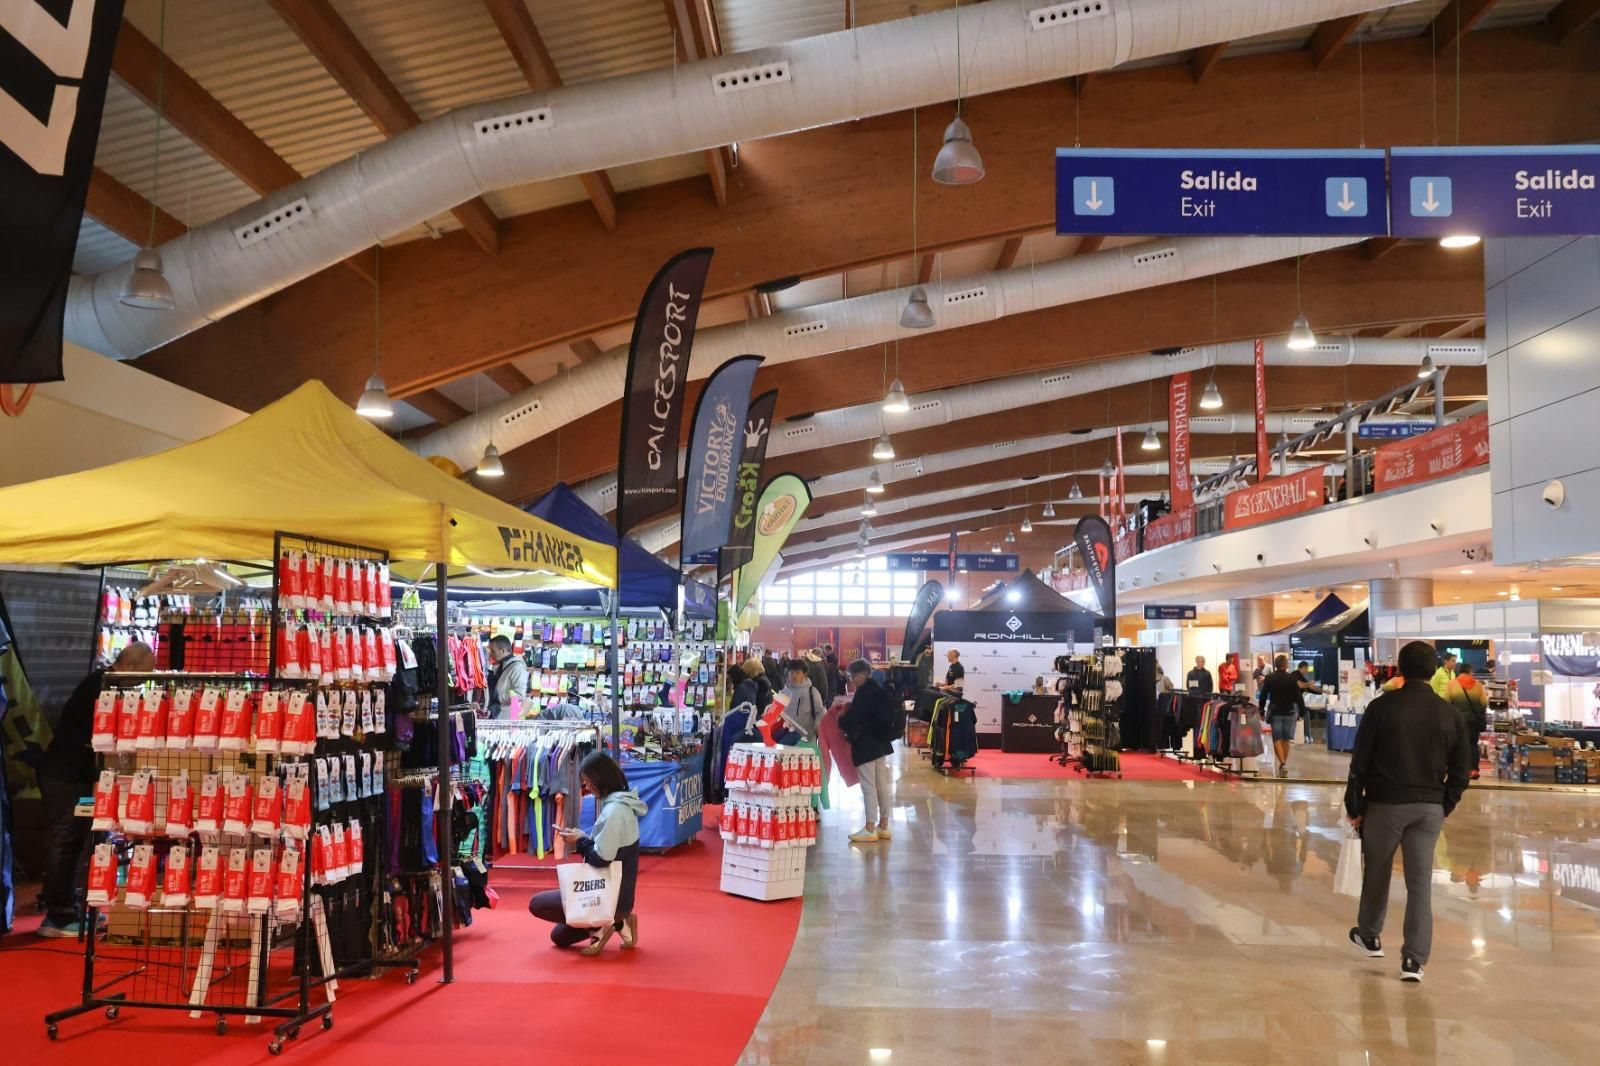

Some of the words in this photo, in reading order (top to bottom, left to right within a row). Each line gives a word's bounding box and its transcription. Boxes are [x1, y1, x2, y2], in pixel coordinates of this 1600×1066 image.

[1180, 170, 1258, 192] Salida
[1514, 170, 1596, 191] Salida
[1181, 196, 1216, 218] Exit
[1516, 197, 1553, 219] Exit
[648, 282, 690, 471] CALCESPORT
[1173, 381, 1188, 465] GENERALI
[698, 421, 725, 513] VICTORY
[715, 415, 736, 503] ENDURANCE
[1250, 477, 1307, 514] GENERALI
[573, 878, 606, 893] 226ERS
